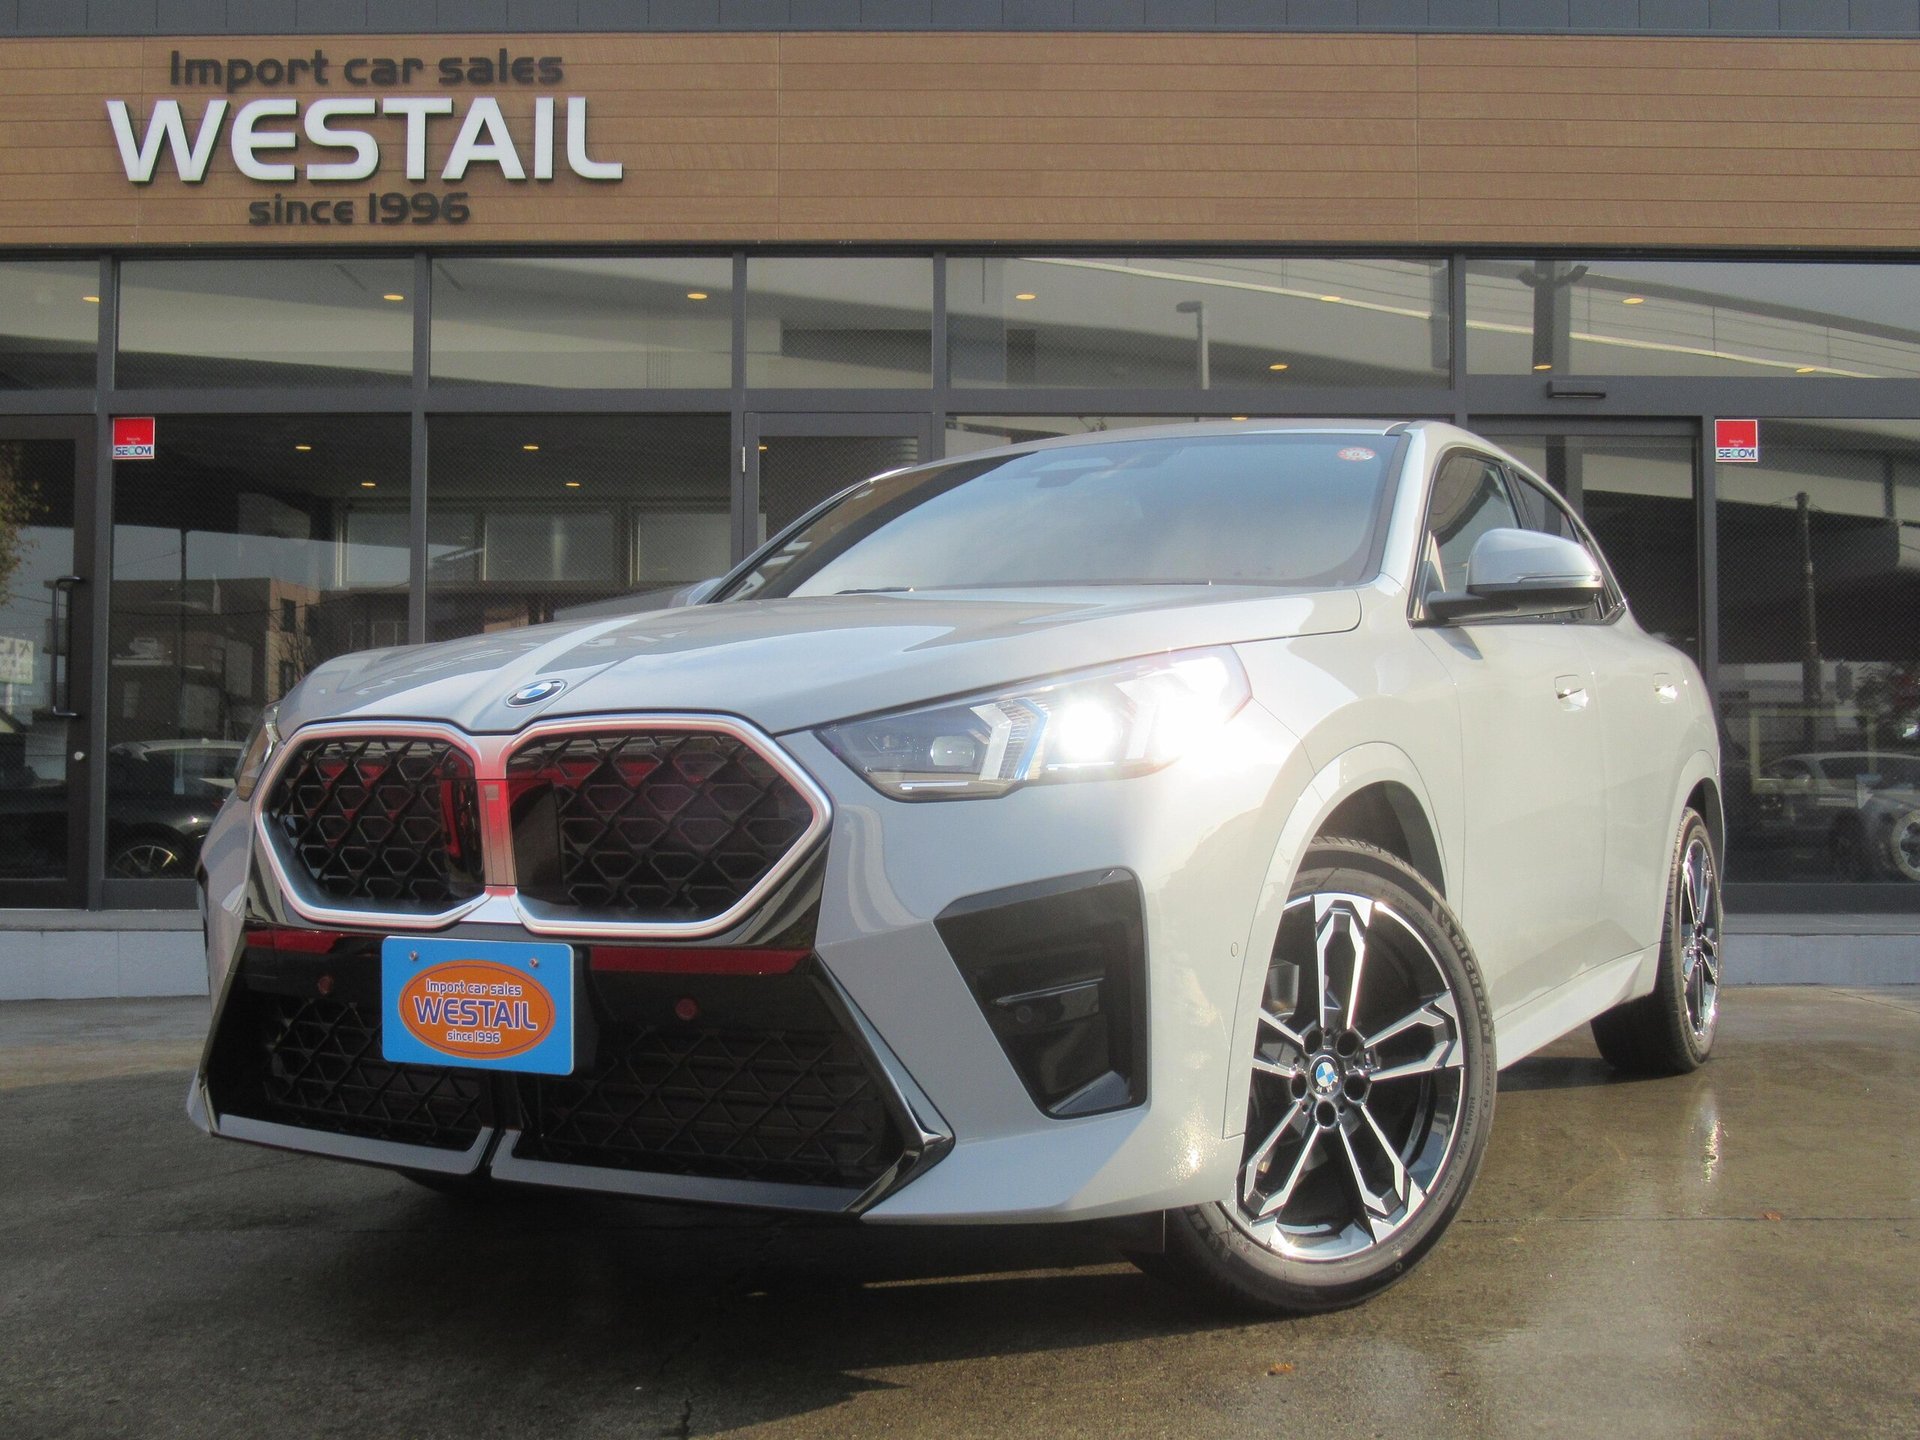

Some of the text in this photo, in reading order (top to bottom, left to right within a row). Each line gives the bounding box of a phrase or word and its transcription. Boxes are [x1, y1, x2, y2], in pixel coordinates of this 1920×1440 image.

[170, 48, 564, 92] Import car sales
[106, 97, 624, 183] WESTAIL
[248, 191, 471, 226] since 1996
[115, 446, 152, 455] SECOM
[1718, 448, 1755, 458] SECOM
[426, 979, 522, 996] Import car sales
[1453, 933, 1490, 1037] MICHELIN
[414, 997, 537, 1030] WESTAIL
[447, 1029, 501, 1044] since 1996
